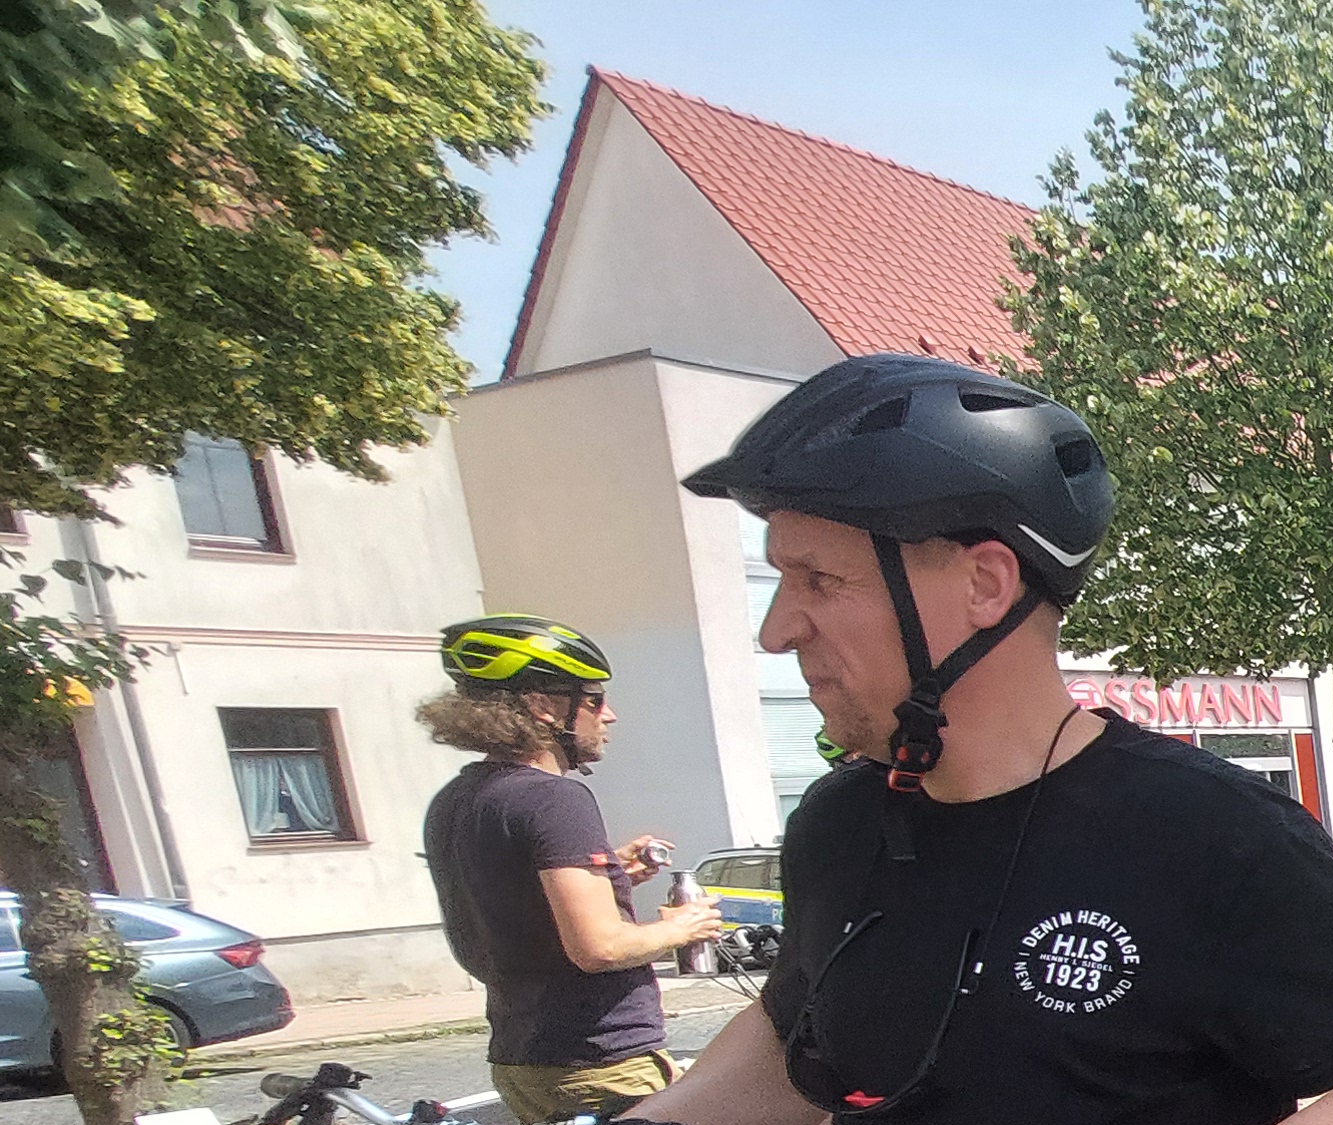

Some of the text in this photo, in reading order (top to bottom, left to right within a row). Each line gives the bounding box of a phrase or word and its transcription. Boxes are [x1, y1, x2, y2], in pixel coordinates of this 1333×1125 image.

[1067, 678, 1282, 725] OSSMANN
[1022, 909, 1140, 965] DENIM HERITAGE
[1051, 933, 1109, 963] H.I.S
[1014, 961, 1132, 1014] NEW YORK BRAND
[1045, 962, 1101, 992] 1923
